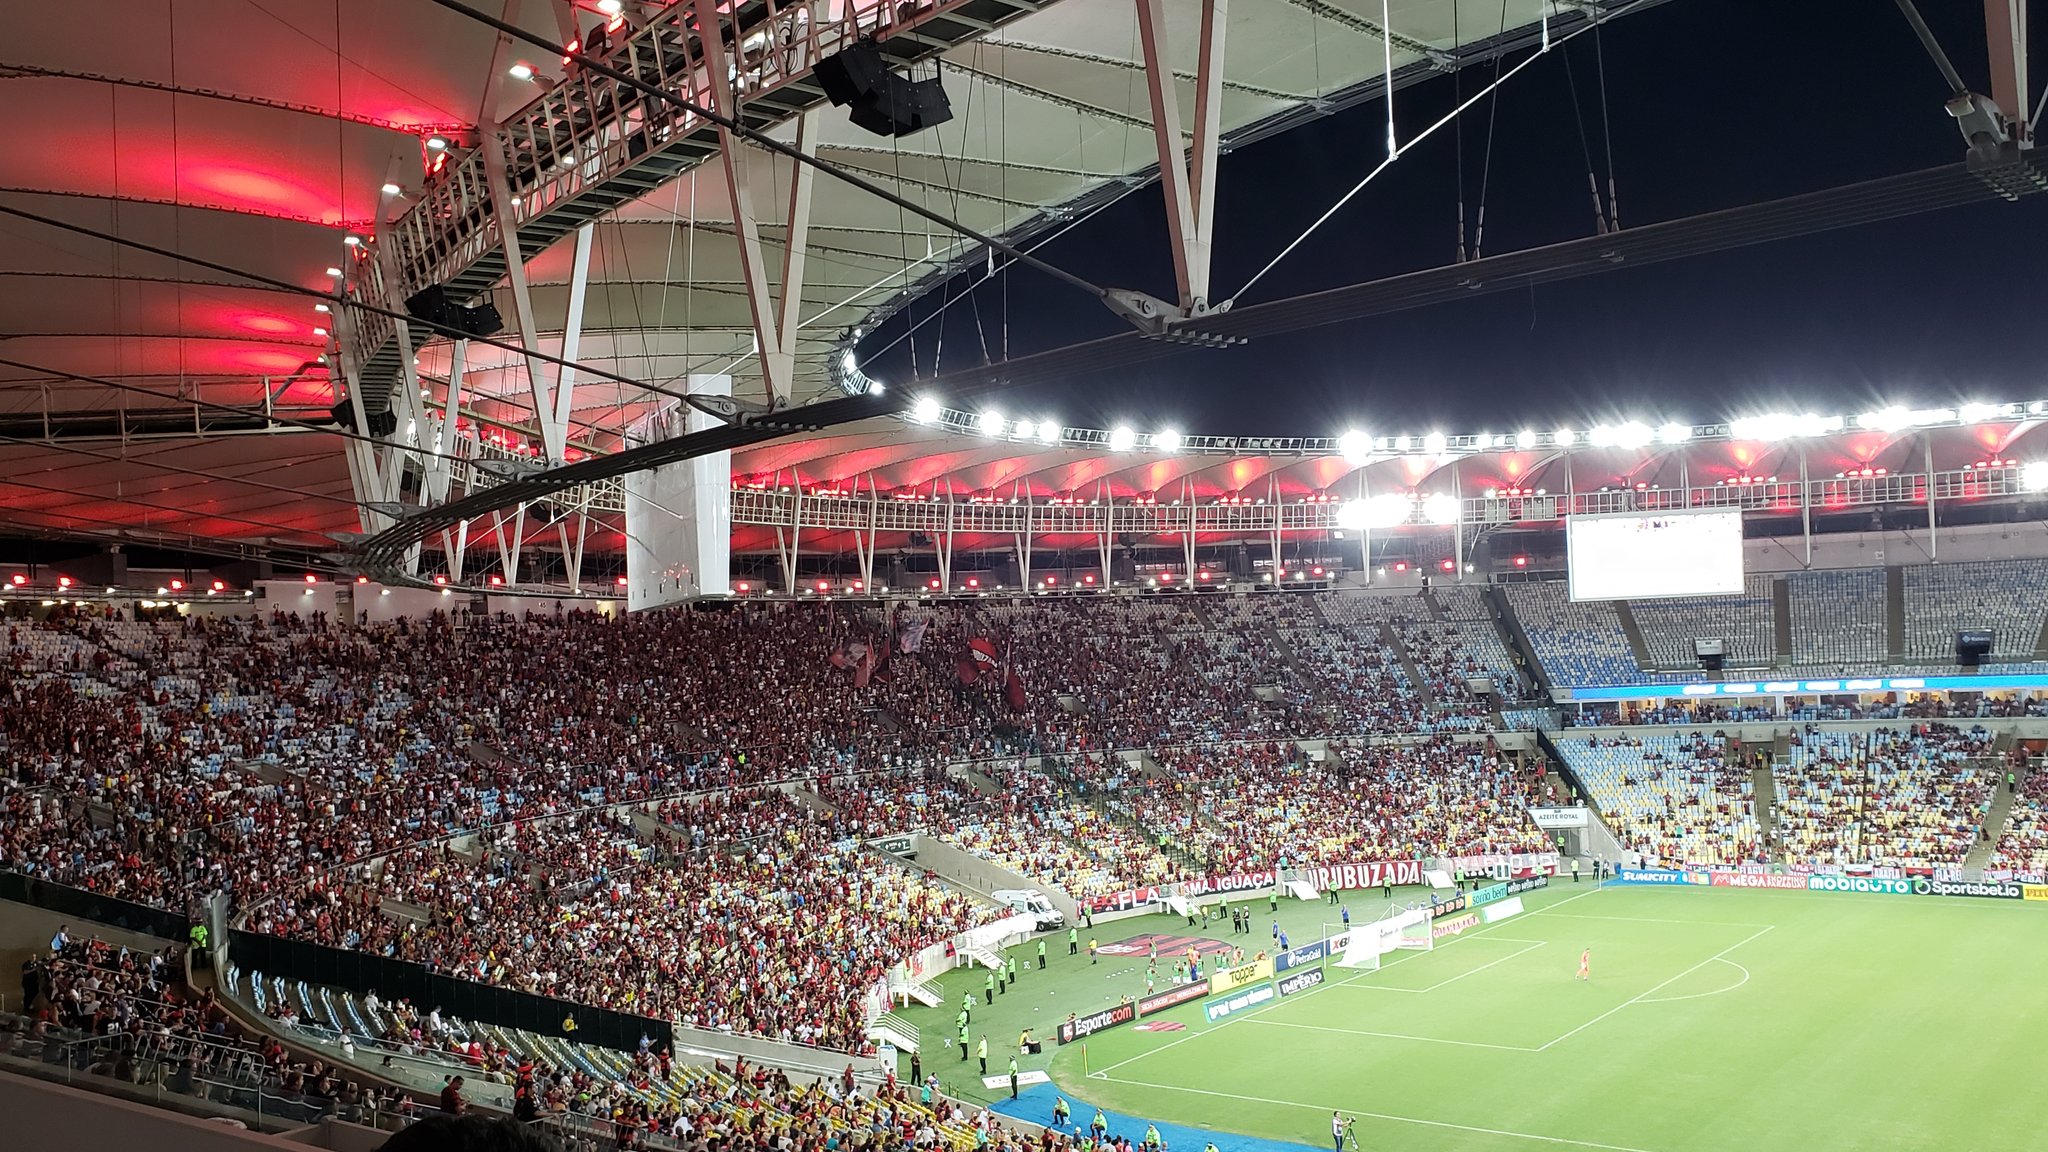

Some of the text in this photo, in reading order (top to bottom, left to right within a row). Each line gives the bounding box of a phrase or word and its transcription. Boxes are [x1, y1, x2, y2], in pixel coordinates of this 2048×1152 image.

[1307, 861, 1421, 891] URUBUZADA
[1622, 871, 1678, 883] SUMICITY
[1729, 873, 1767, 887] MEGA
[1117, 887, 1160, 910] FLA
[1932, 881, 2019, 897] Sportsbet.io
[1074, 1006, 1132, 1036] Esportecom
